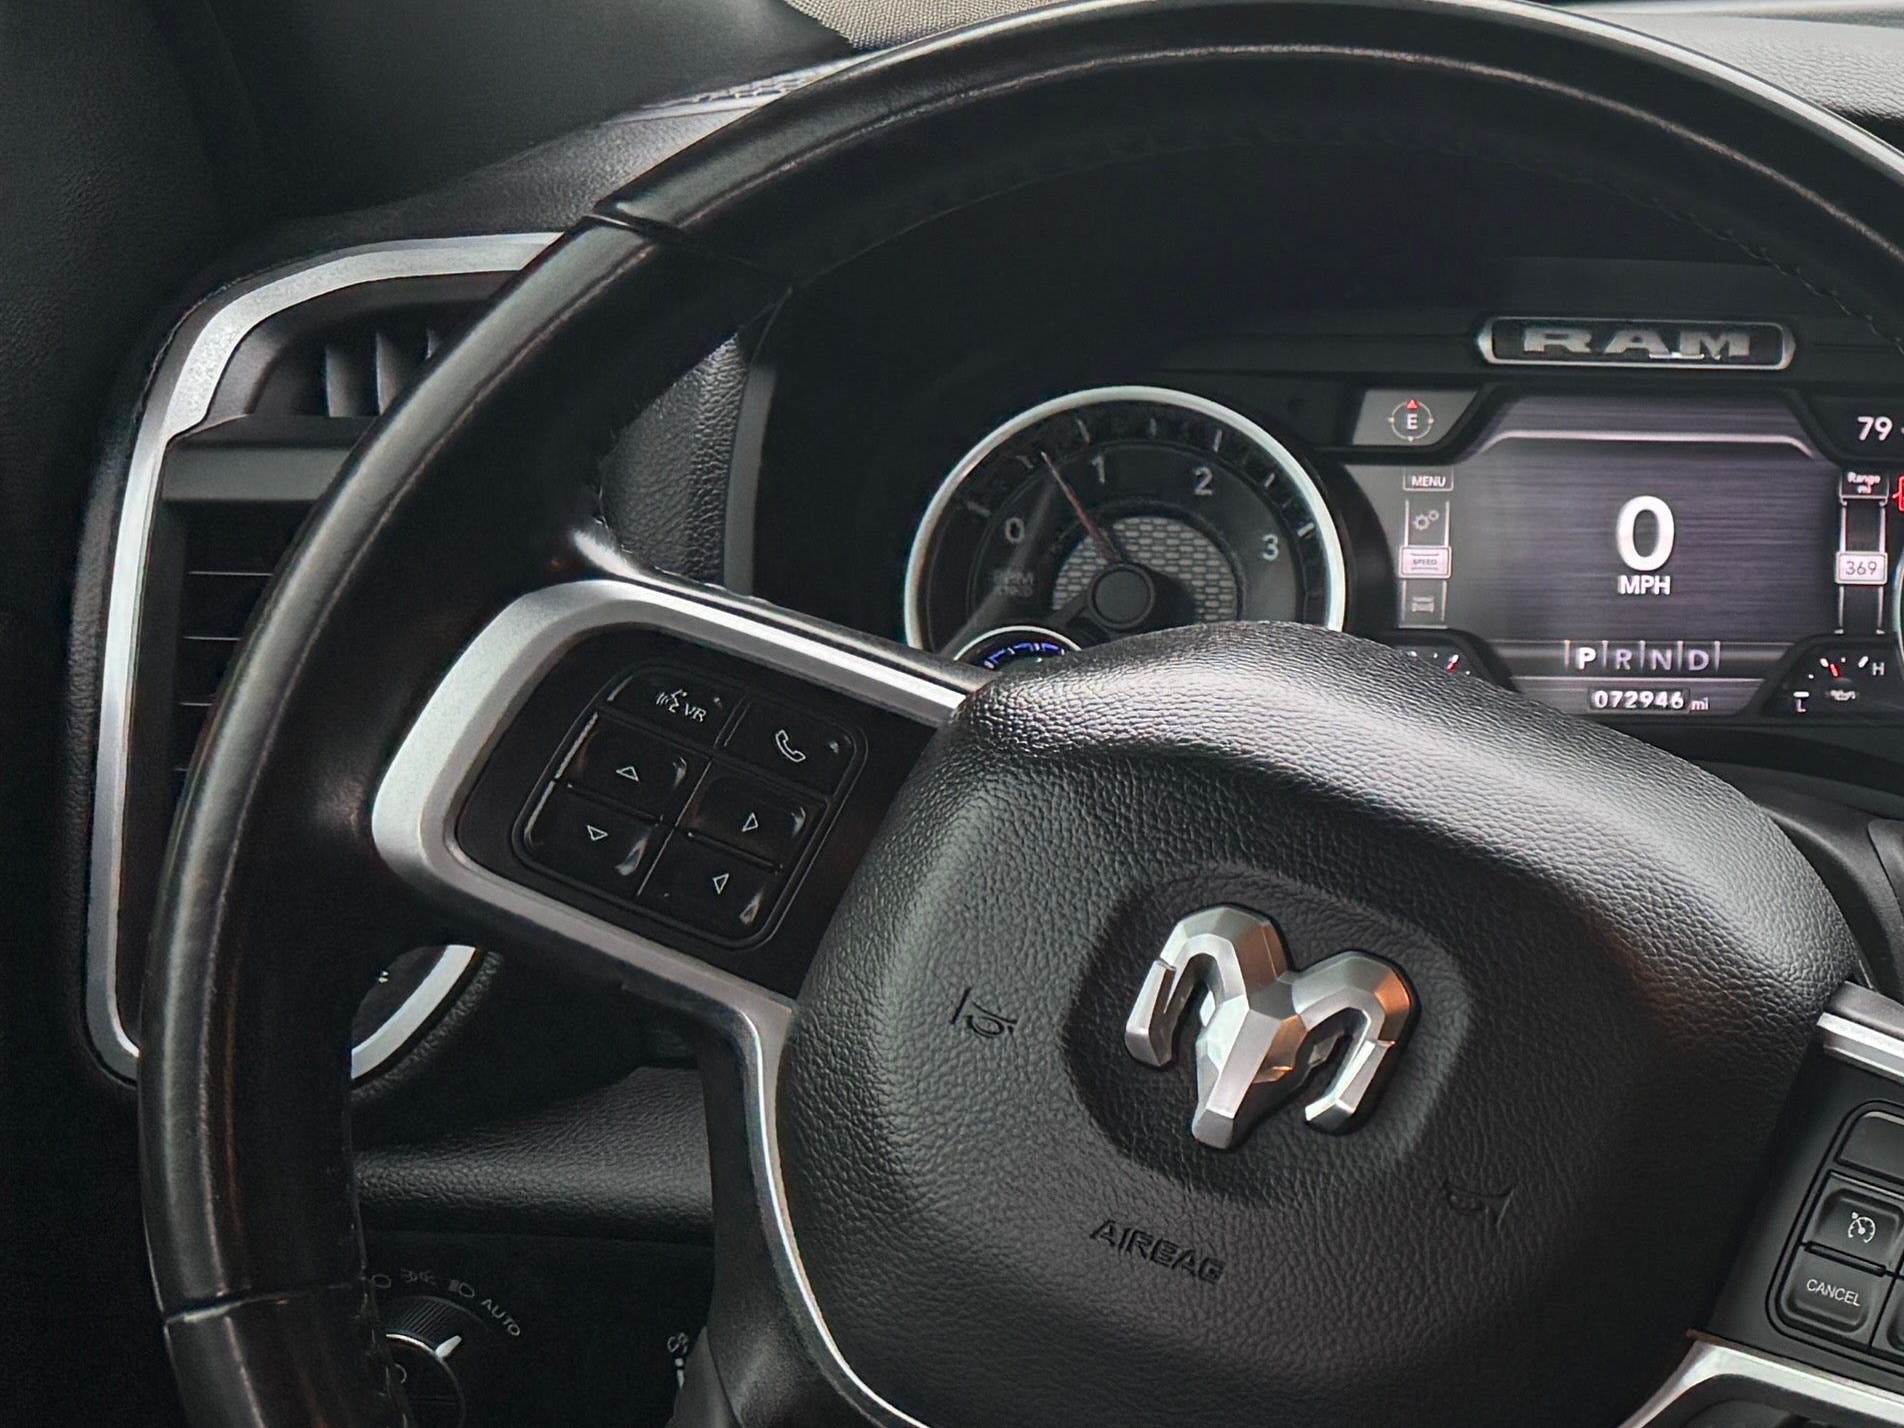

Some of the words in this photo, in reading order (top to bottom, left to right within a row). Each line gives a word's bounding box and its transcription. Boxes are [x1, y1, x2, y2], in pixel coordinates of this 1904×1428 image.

[1523, 327, 1751, 358] RAM
[1406, 414, 1418, 430] E
[1857, 417, 1893, 441] 79
[1091, 455, 1105, 484] 1
[1194, 467, 1213, 496] 2
[1411, 474, 1446, 487] MENU
[1005, 517, 1025, 544] 0
[1616, 494, 1675, 572] 0
[1262, 535, 1280, 561] 3
[1846, 561, 1877, 576] 369
[1618, 575, 1671, 595] MPH
[1578, 647, 1596, 669] P
[1616, 649, 1632, 670] R
[1652, 649, 1673, 671] N
[1688, 650, 1710, 671] D
[1871, 662, 1885, 677] H
[1594, 689, 1684, 710] 072946
[1691, 696, 1710, 711] mi
[1796, 700, 1806, 713] L
[684, 703, 707, 723] VR
[1089, 1219, 1226, 1284] AIRBAG
[1806, 1277, 1861, 1308] CANCEL
[480, 1298, 521, 1337] AUTO
